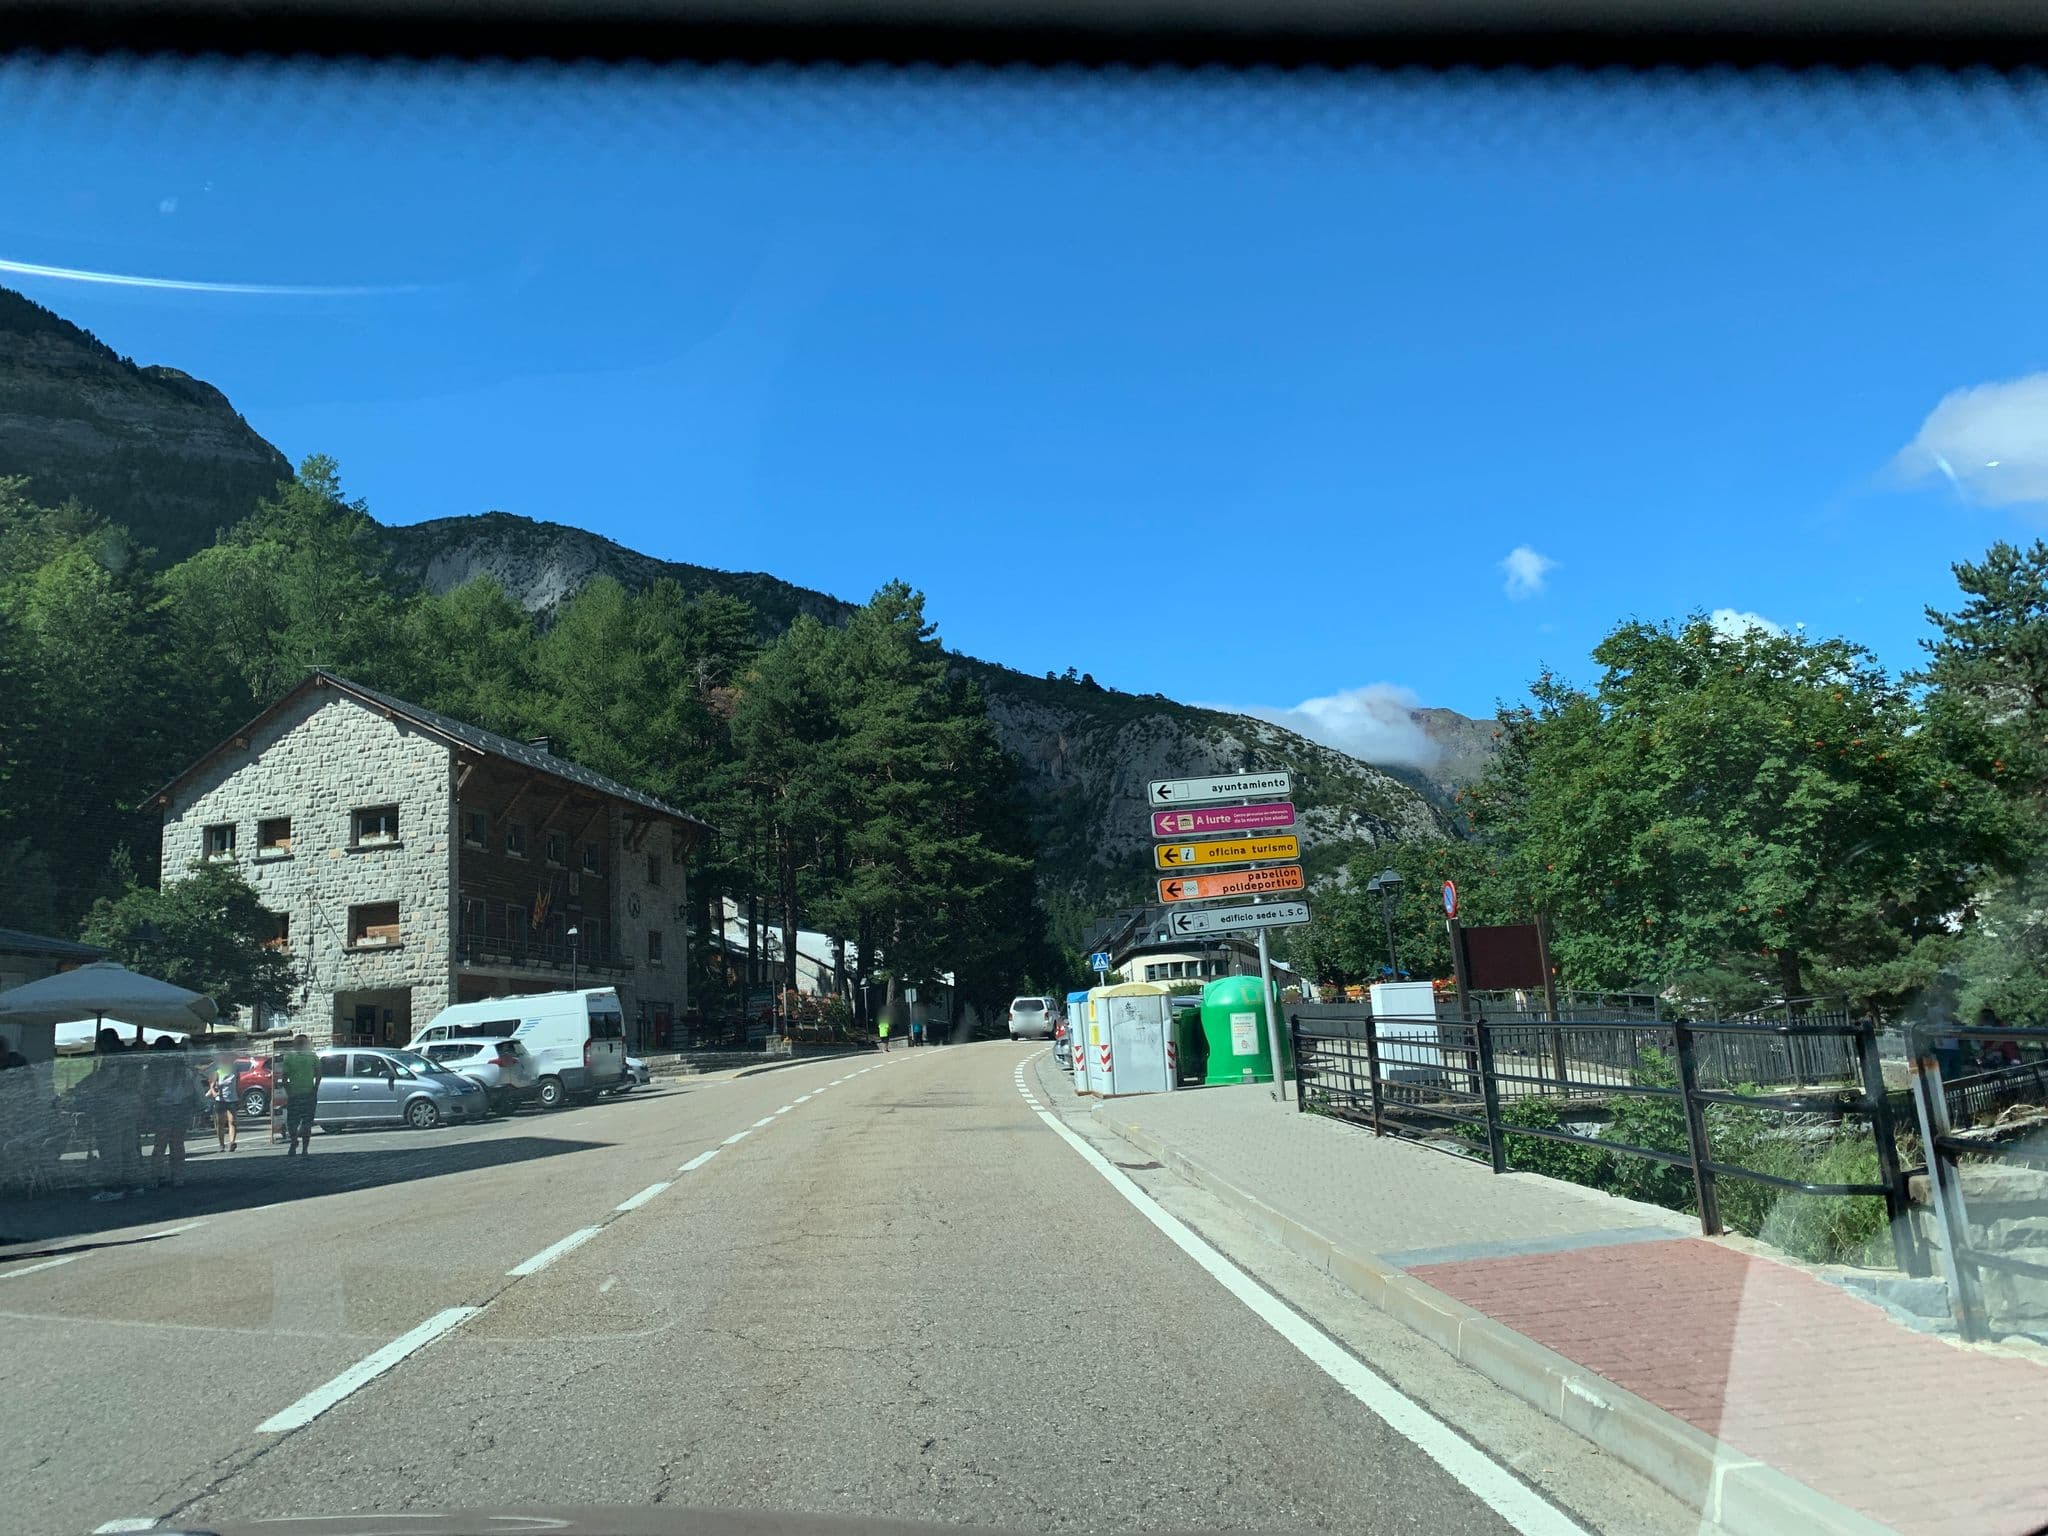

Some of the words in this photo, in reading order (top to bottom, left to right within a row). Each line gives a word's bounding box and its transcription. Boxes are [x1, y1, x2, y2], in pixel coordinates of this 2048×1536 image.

[1212, 779, 1286, 793] ayuntamiento
[1196, 816, 1204, 825] A
[1209, 847, 1246, 857] oficina
[1252, 843, 1293, 853] turismo
[1222, 879, 1298, 894] polideportivo
[1220, 913, 1254, 923] edificio
[1256, 911, 1277, 920] sede
